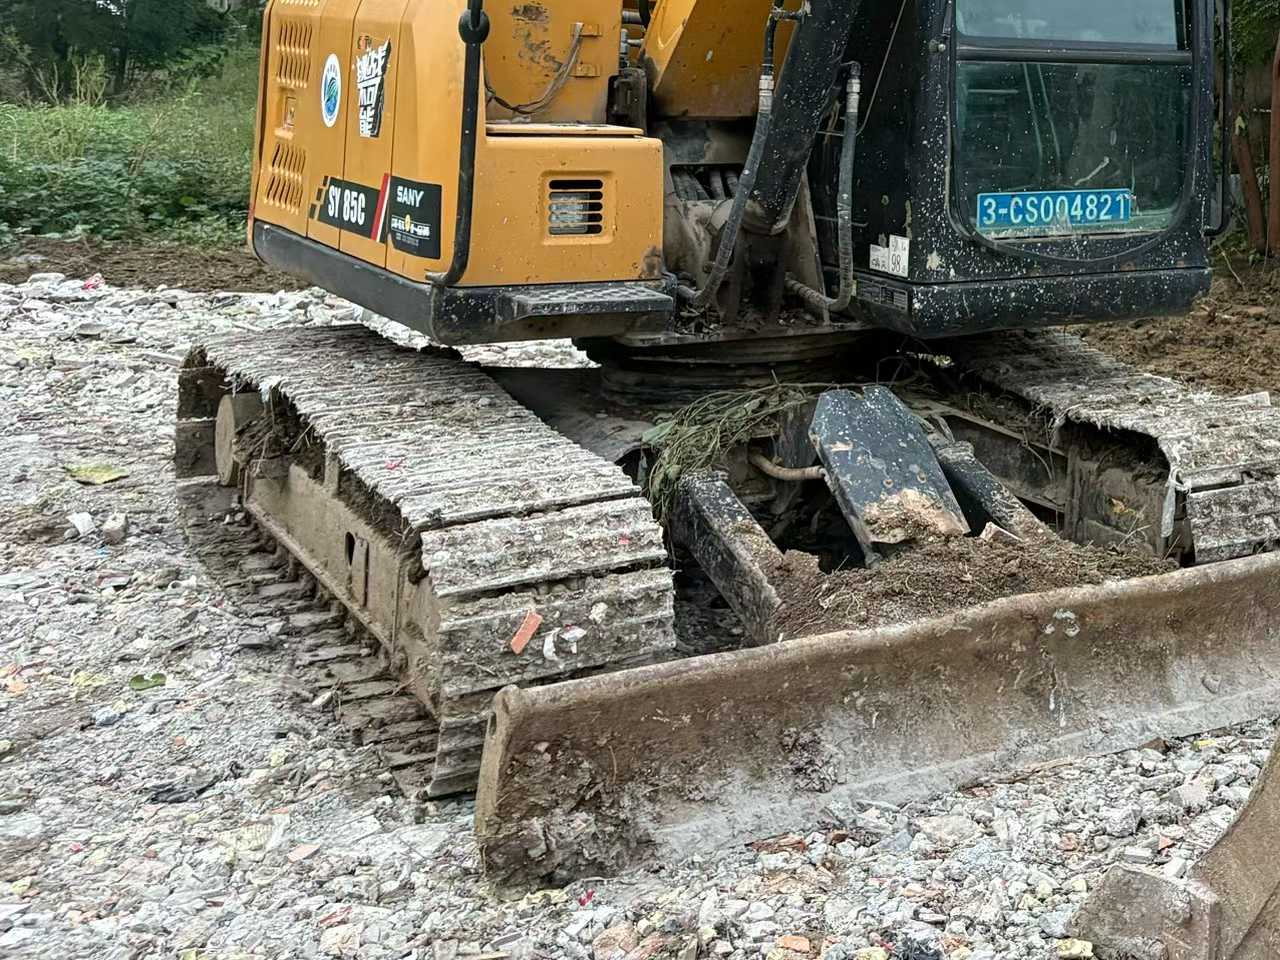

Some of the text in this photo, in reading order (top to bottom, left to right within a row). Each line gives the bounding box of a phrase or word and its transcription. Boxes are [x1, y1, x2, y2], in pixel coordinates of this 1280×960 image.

[328, 185, 366, 225] SY 85C
[396, 186, 424, 207] SANY
[982, 193, 1125, 225] 3-CS004821
